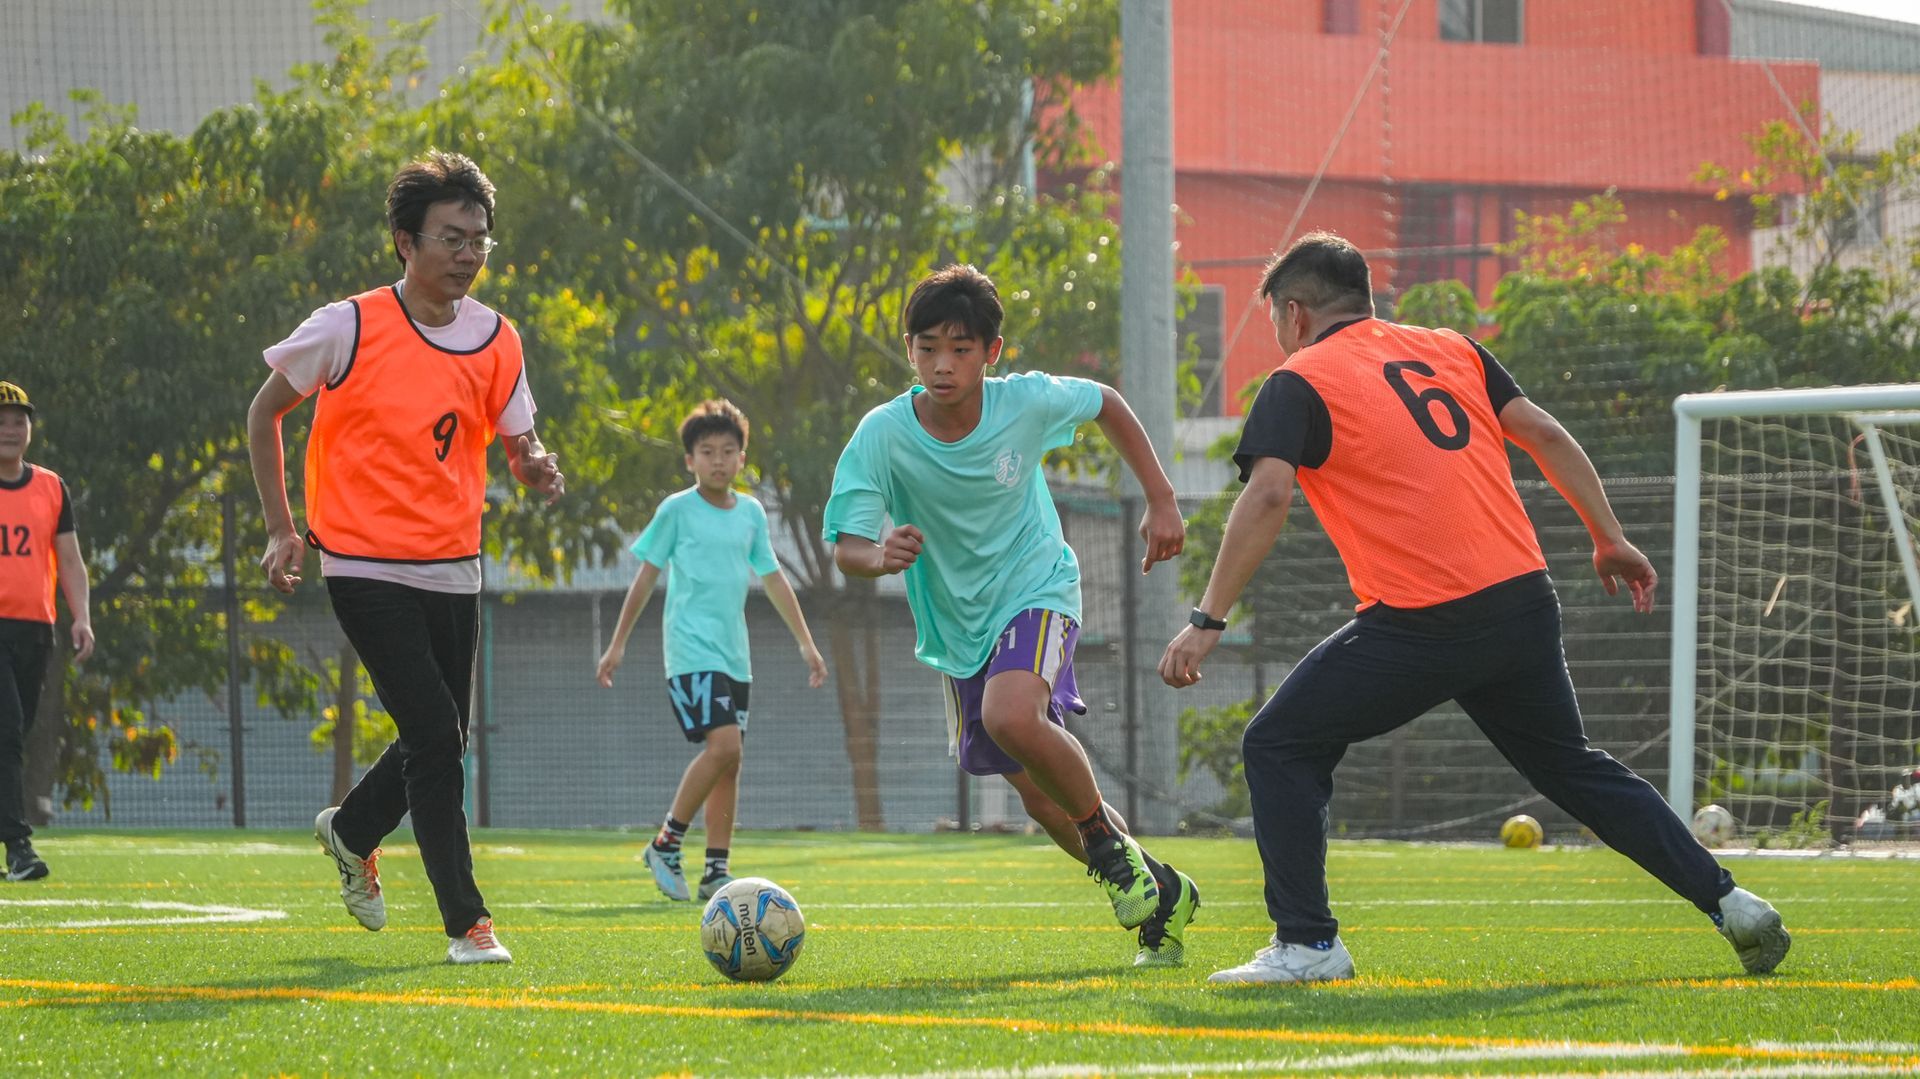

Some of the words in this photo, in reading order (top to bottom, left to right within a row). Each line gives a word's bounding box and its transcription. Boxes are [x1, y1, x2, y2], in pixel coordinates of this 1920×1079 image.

[1383, 361, 1470, 451] 6
[433, 411, 458, 462] 9
[0, 524, 31, 556] 12
[739, 903, 757, 956] molten
